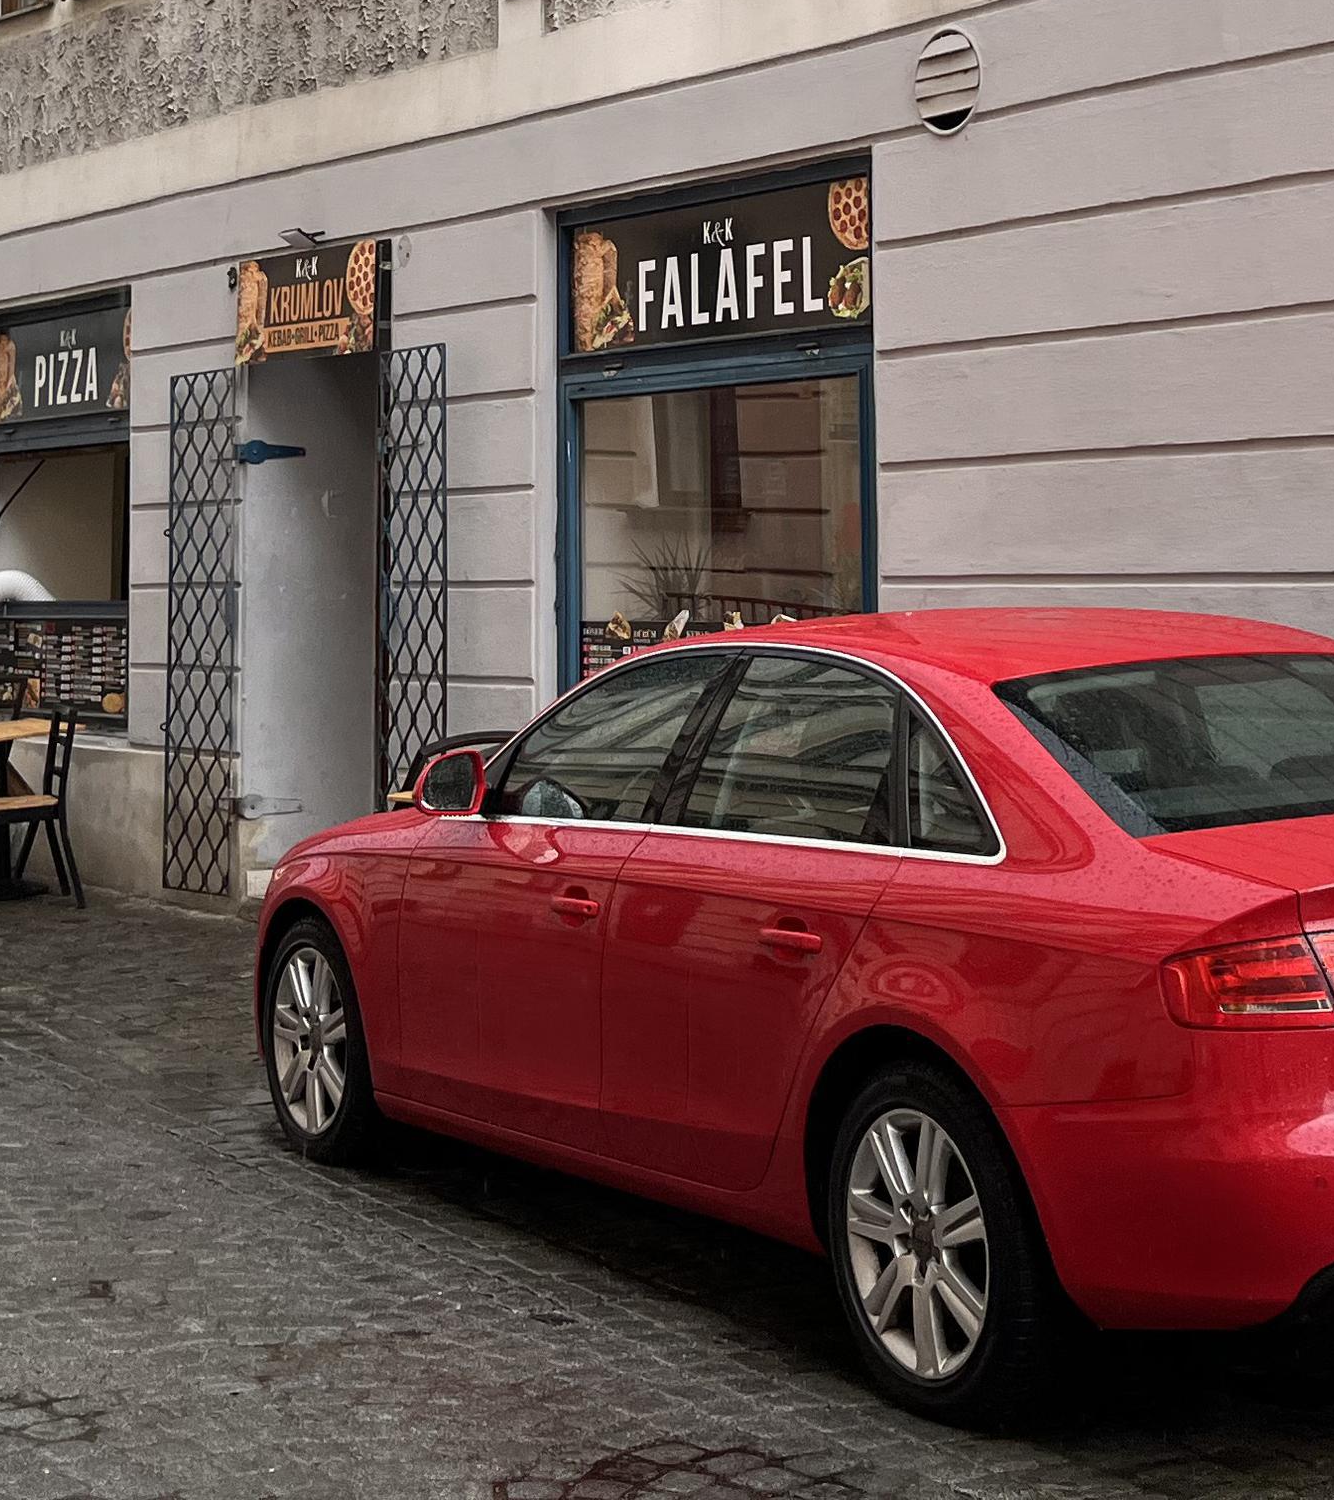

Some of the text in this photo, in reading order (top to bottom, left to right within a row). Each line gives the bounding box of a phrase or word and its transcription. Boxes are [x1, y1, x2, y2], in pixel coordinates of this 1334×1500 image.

[702, 217, 734, 246] K&K
[295, 256, 318, 280] K&K
[637, 235, 825, 332] FALAFEL
[269, 277, 345, 325] KRUMLOV
[34, 347, 99, 407] PIZZA
